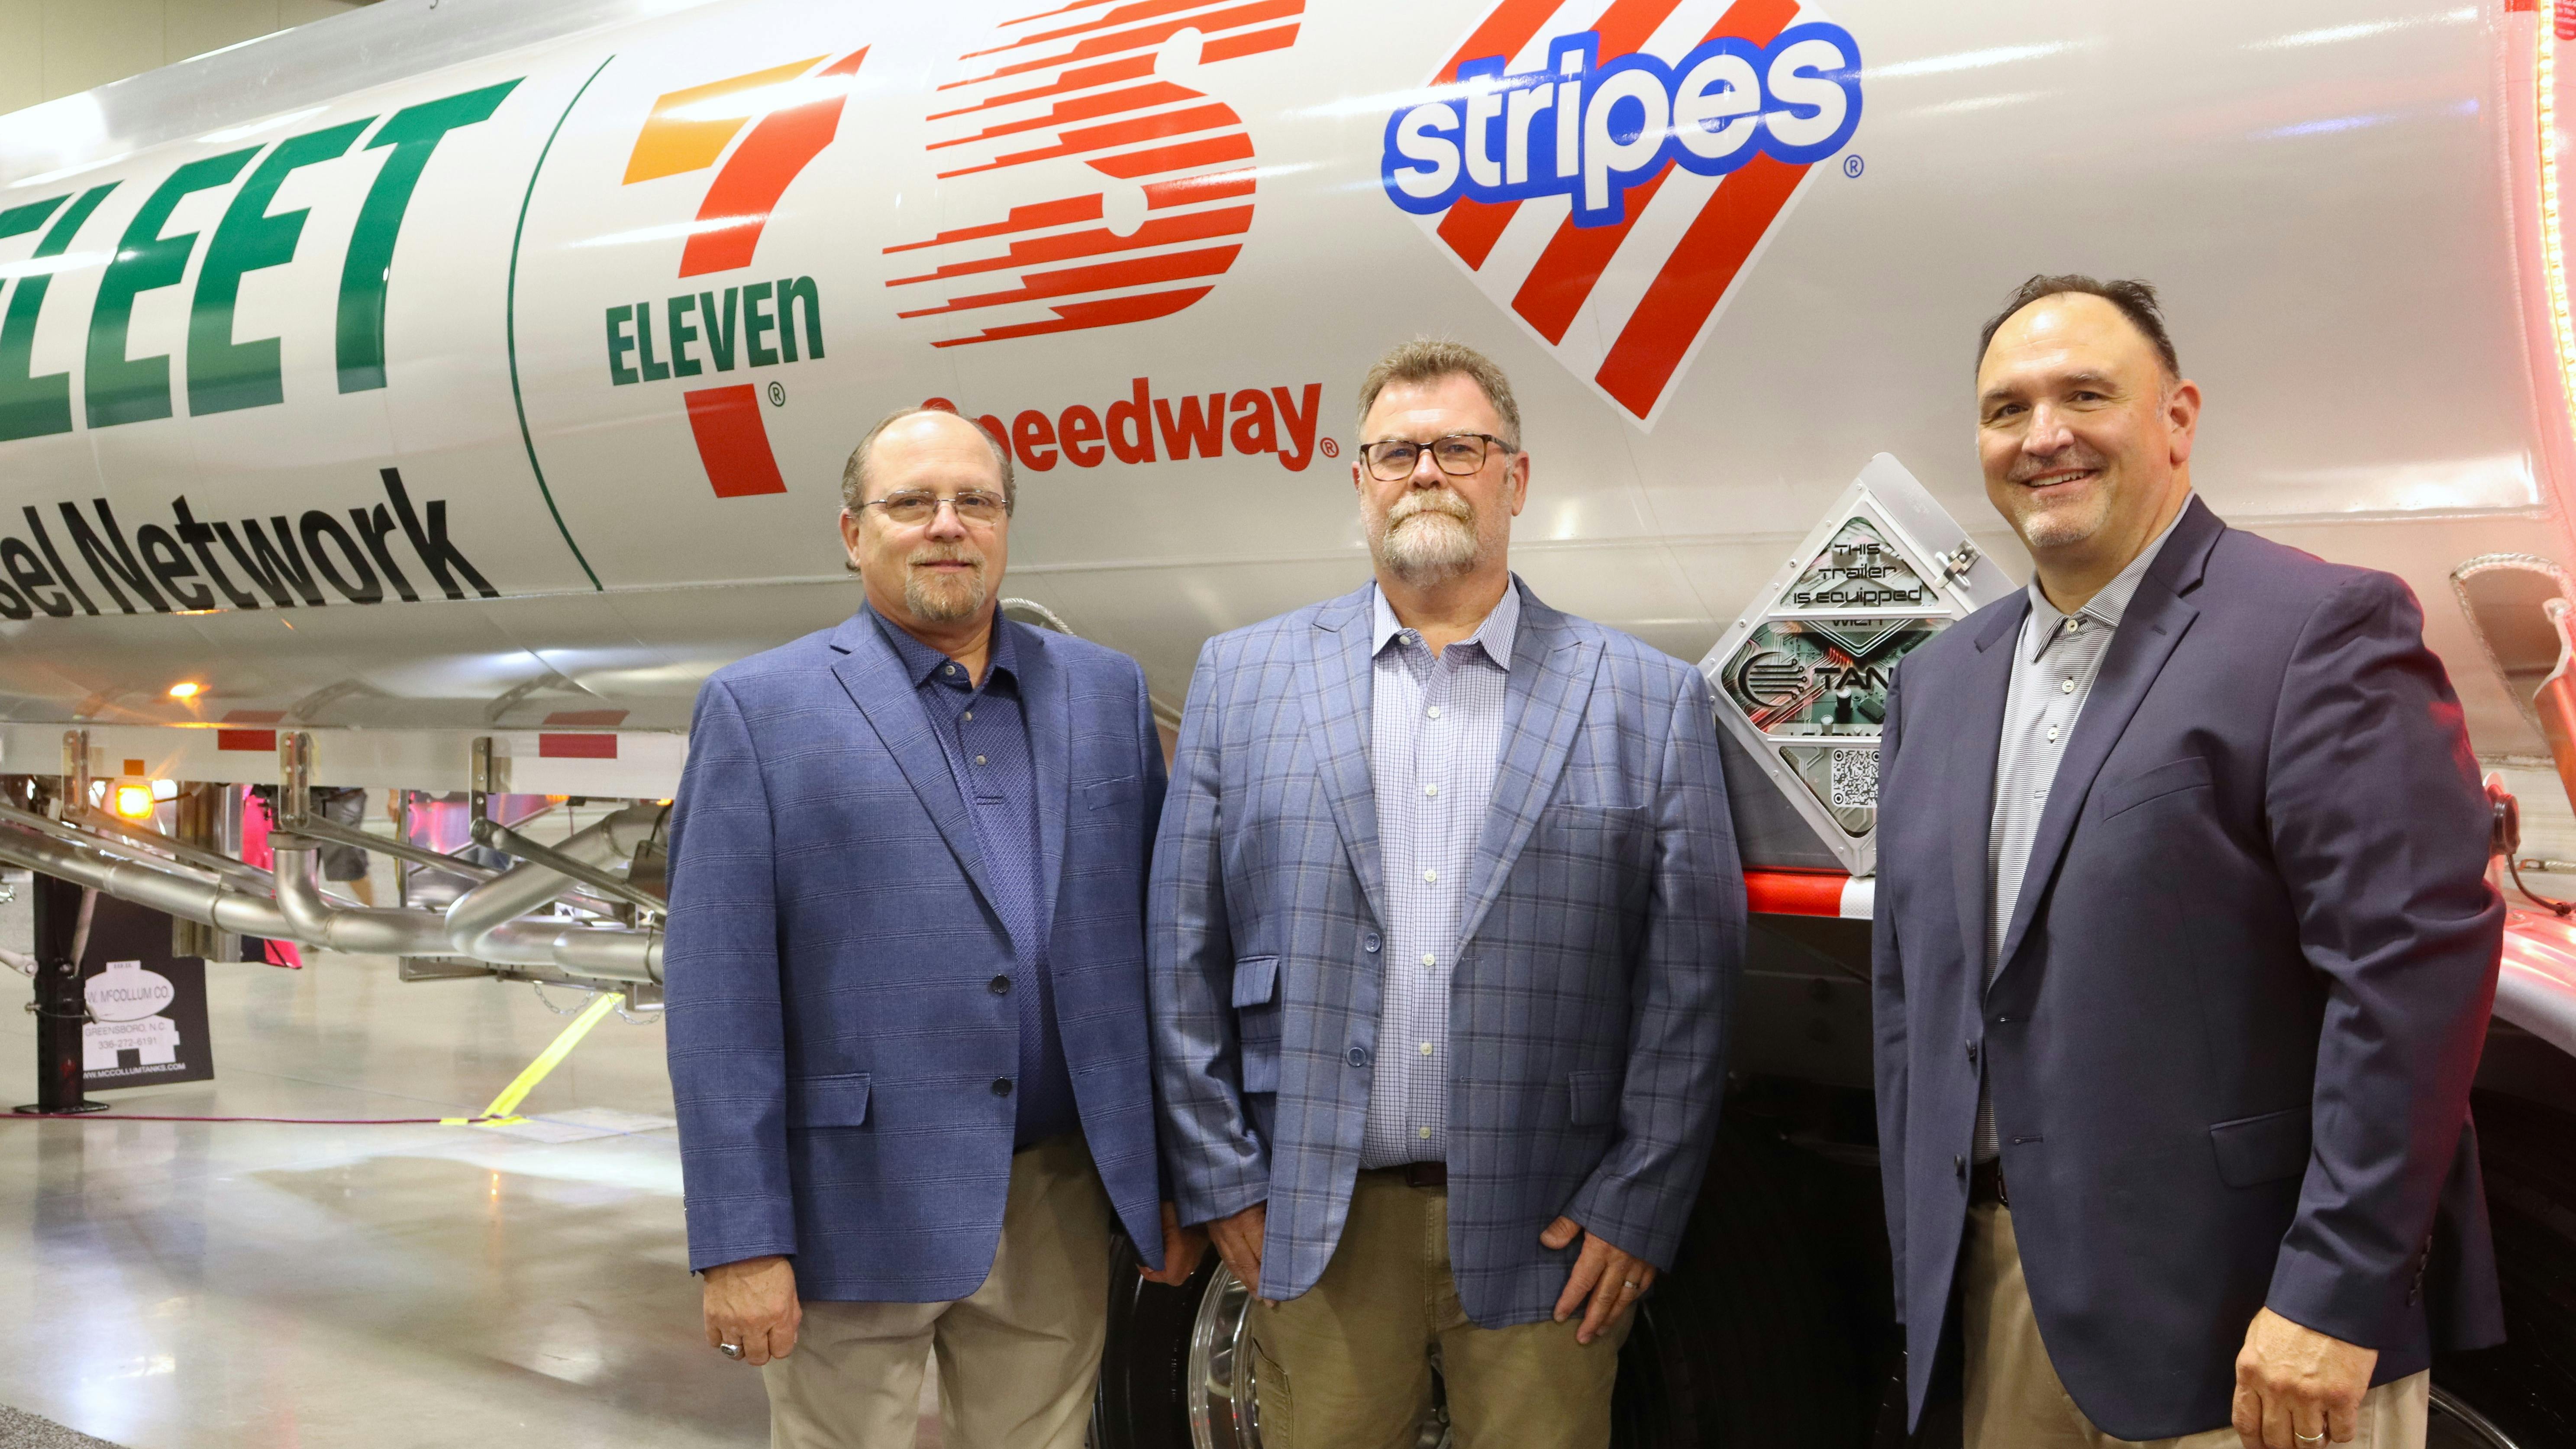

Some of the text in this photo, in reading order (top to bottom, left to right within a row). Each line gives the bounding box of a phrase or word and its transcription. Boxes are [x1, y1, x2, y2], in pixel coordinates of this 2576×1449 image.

[1392, 38, 1848, 211] stripes
[921, 377, 1322, 472] eedway
[58, 467, 501, 615] Network
